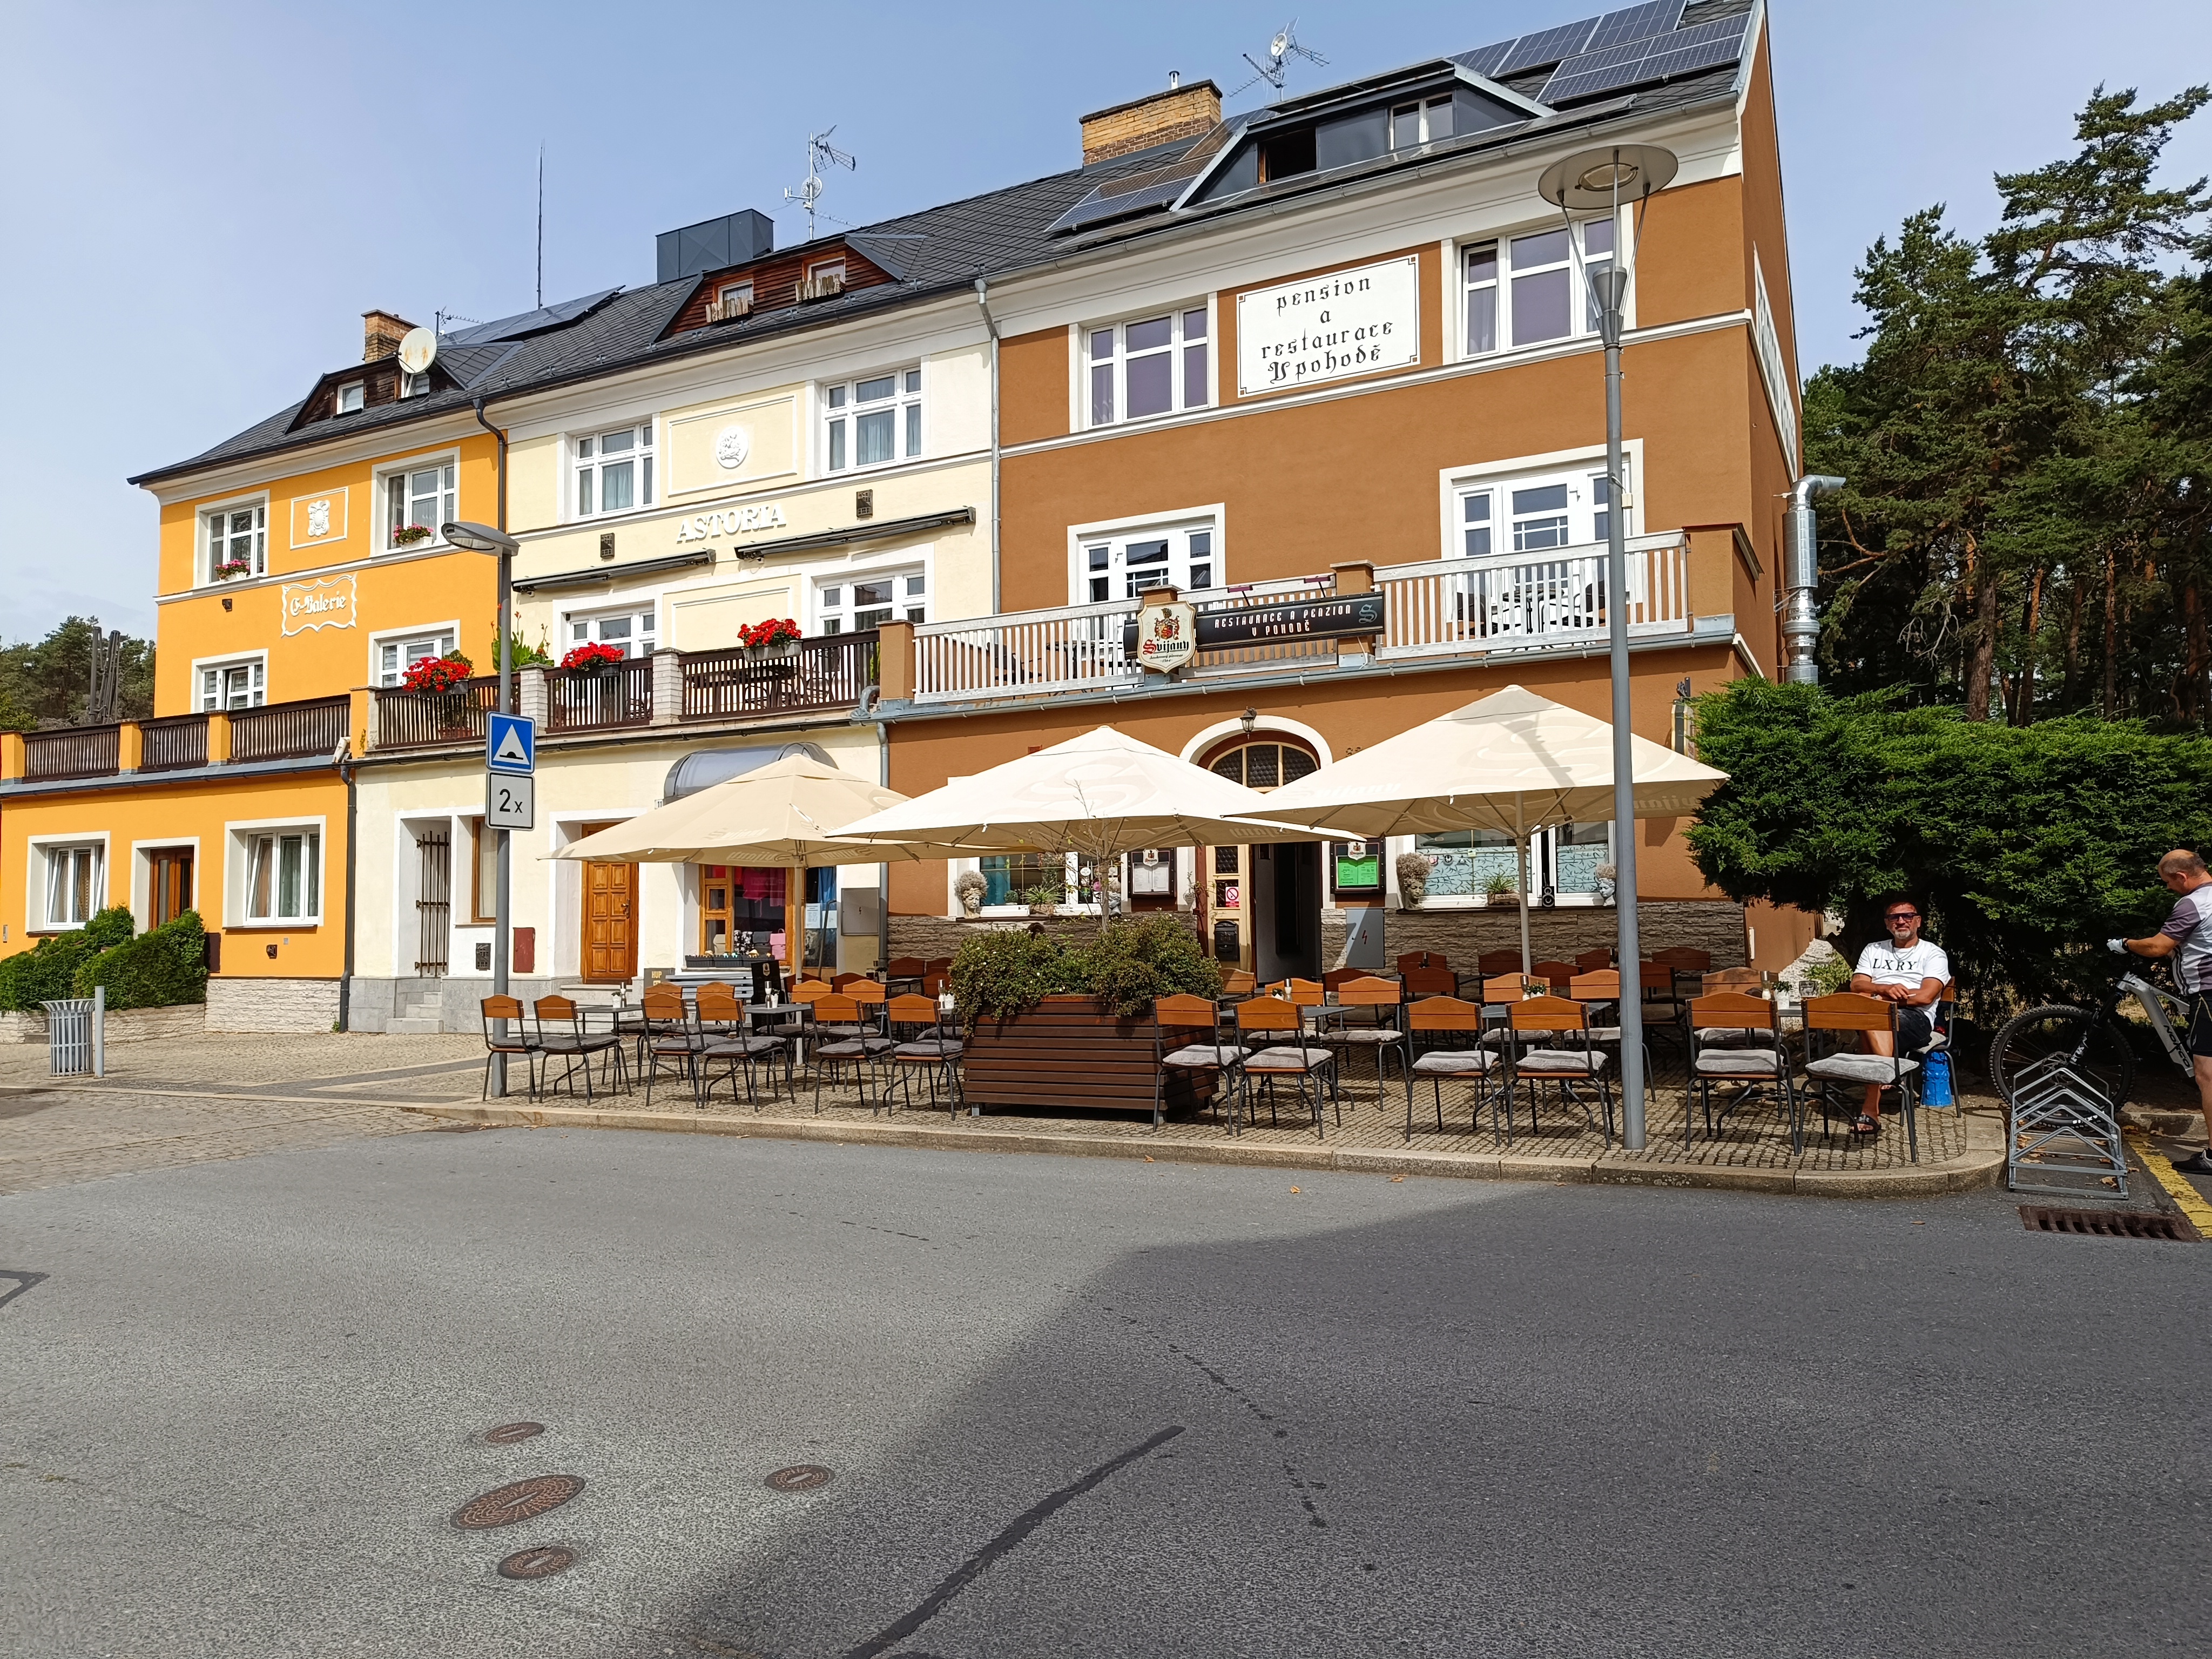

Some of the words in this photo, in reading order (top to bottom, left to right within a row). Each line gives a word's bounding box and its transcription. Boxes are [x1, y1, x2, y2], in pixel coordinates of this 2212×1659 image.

[1276, 278, 1371, 317] pension
[1320, 310, 1331, 323] a
[1261, 321, 1393, 359] restaurace
[676, 504, 787, 544] ASTORIA
[1215, 612, 1282, 629] RESTAURACE
[1290, 611, 1295, 621] A
[1303, 604, 1351, 619] PENZION
[1252, 626, 1257, 637] V
[1265, 620, 1310, 636] POHODĚ
[1142, 639, 1189, 655] Svijany
[1872, 958, 1918, 971] LXRY
